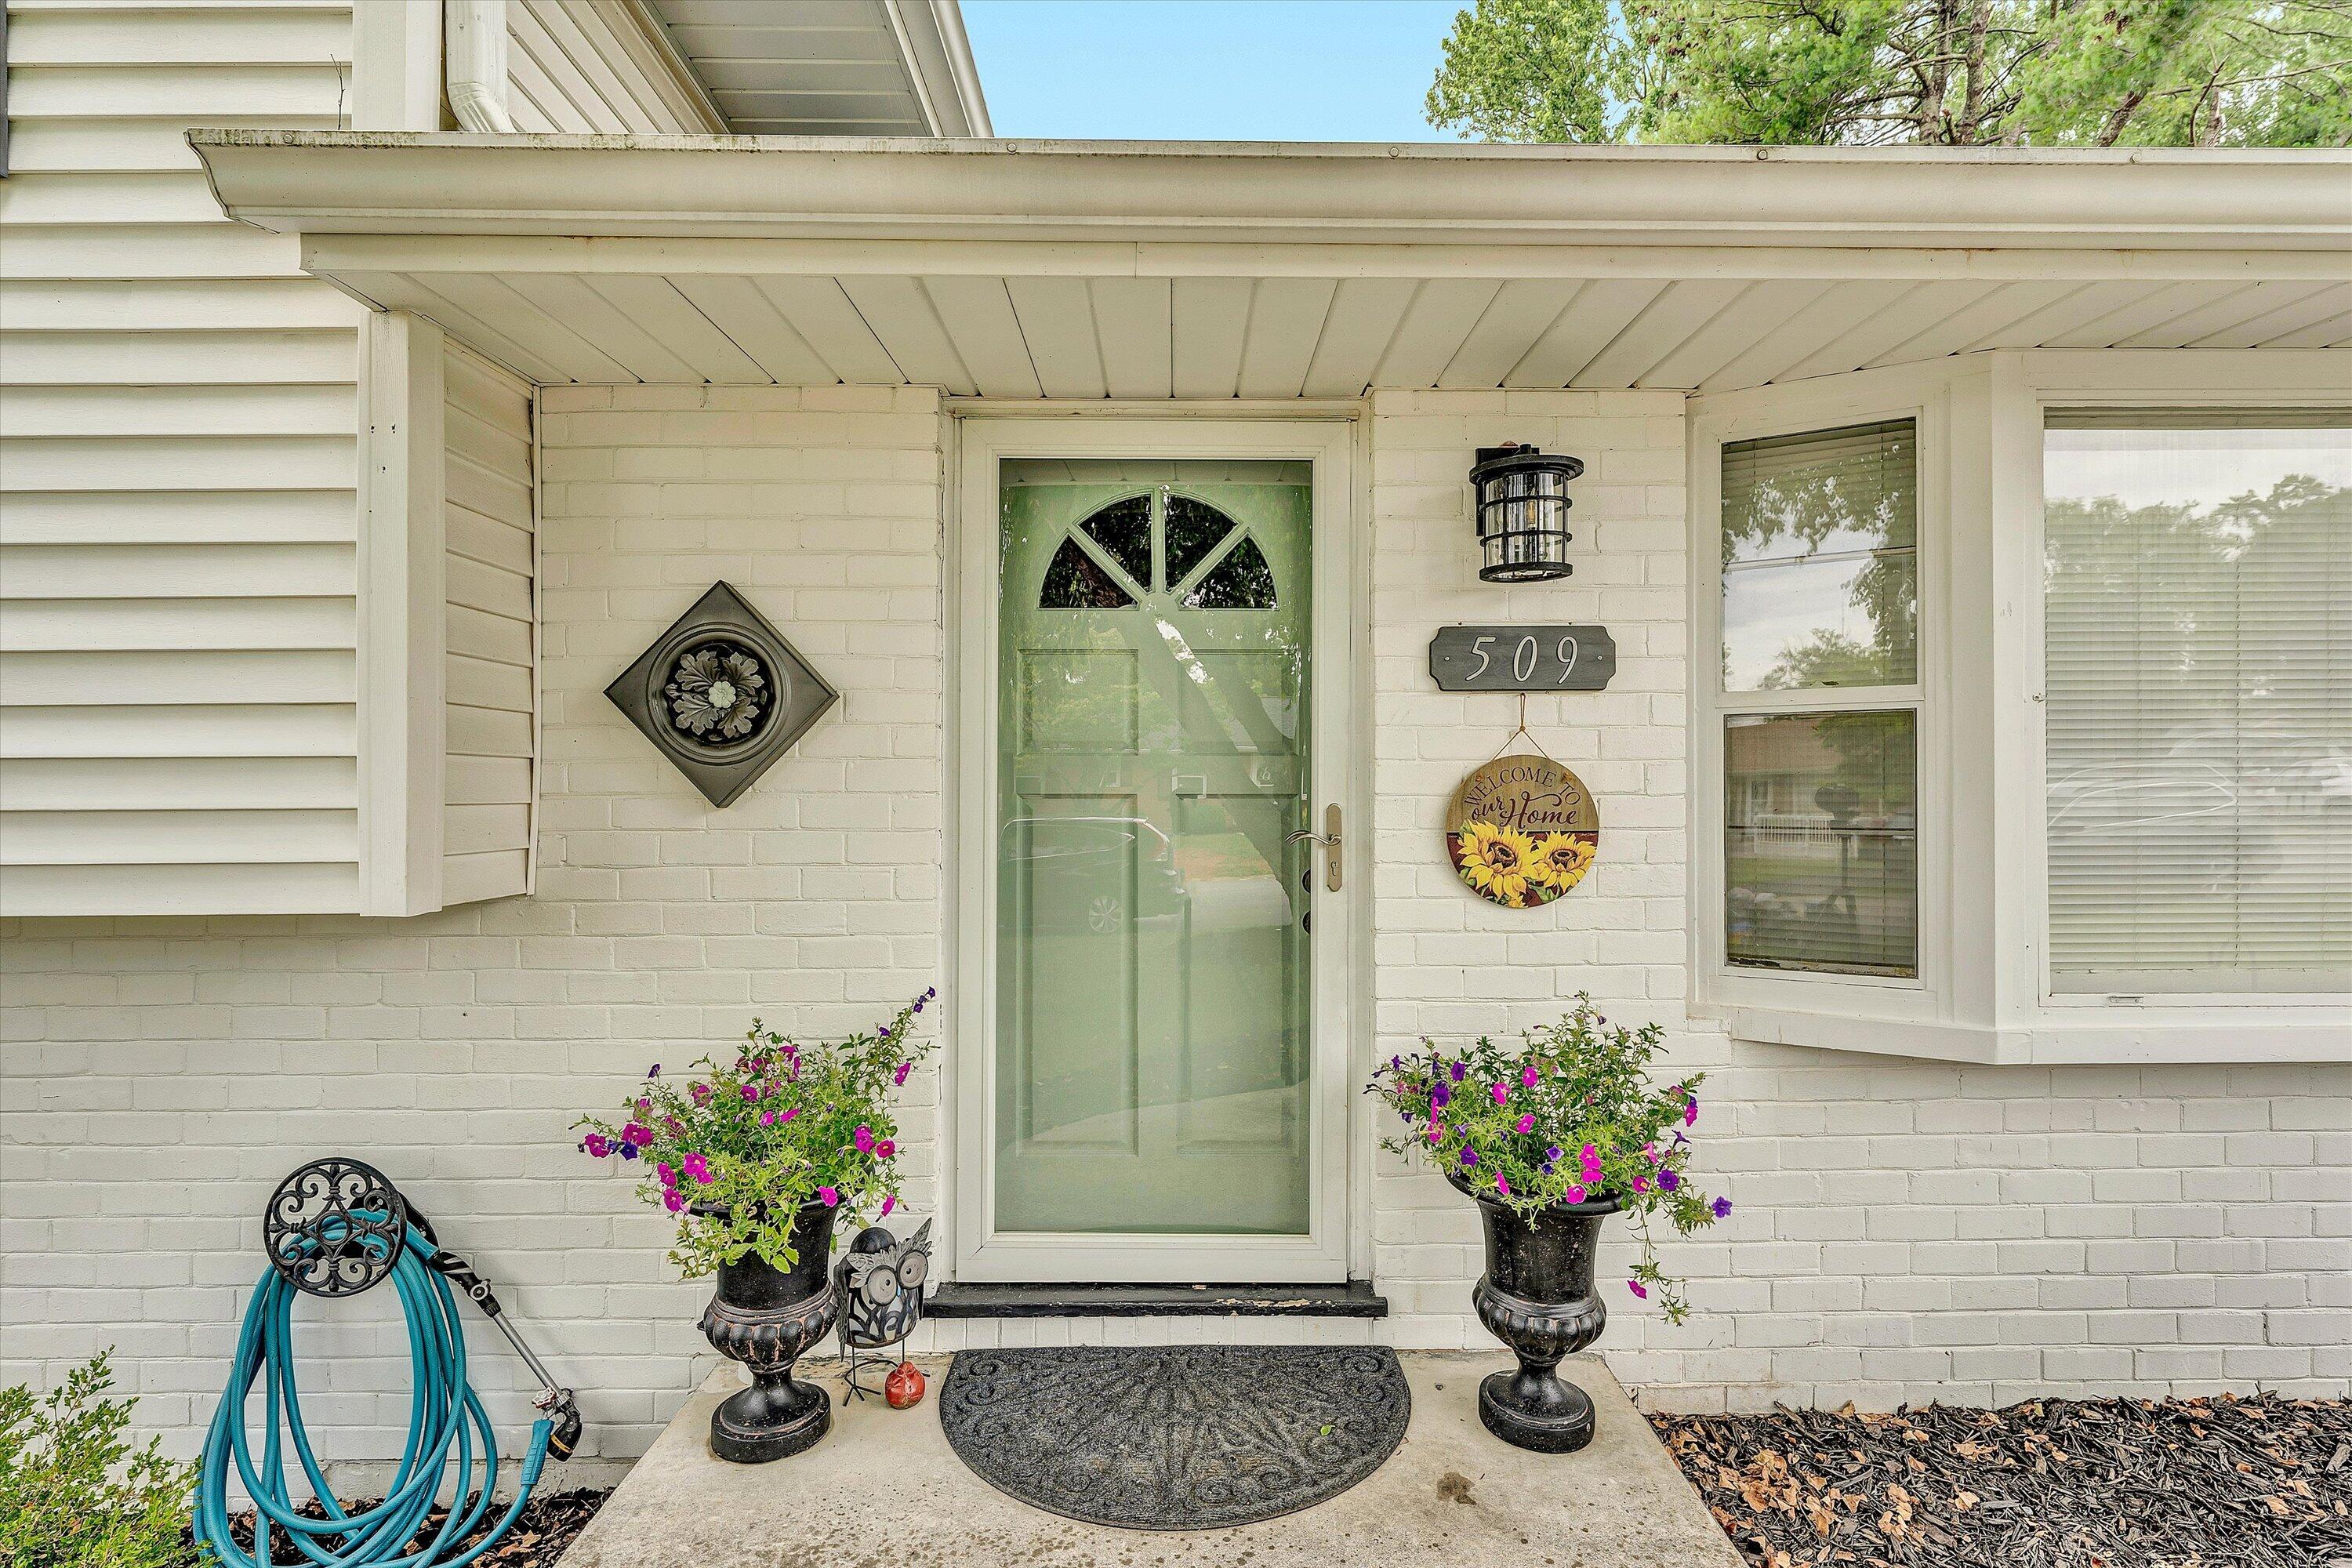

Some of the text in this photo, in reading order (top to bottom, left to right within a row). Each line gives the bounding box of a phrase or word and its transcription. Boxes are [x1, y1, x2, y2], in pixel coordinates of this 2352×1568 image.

[1465, 635, 1578, 684] 509
[1464, 766, 1581, 807] WELCOME TO
[1472, 790, 1578, 829] our Home
